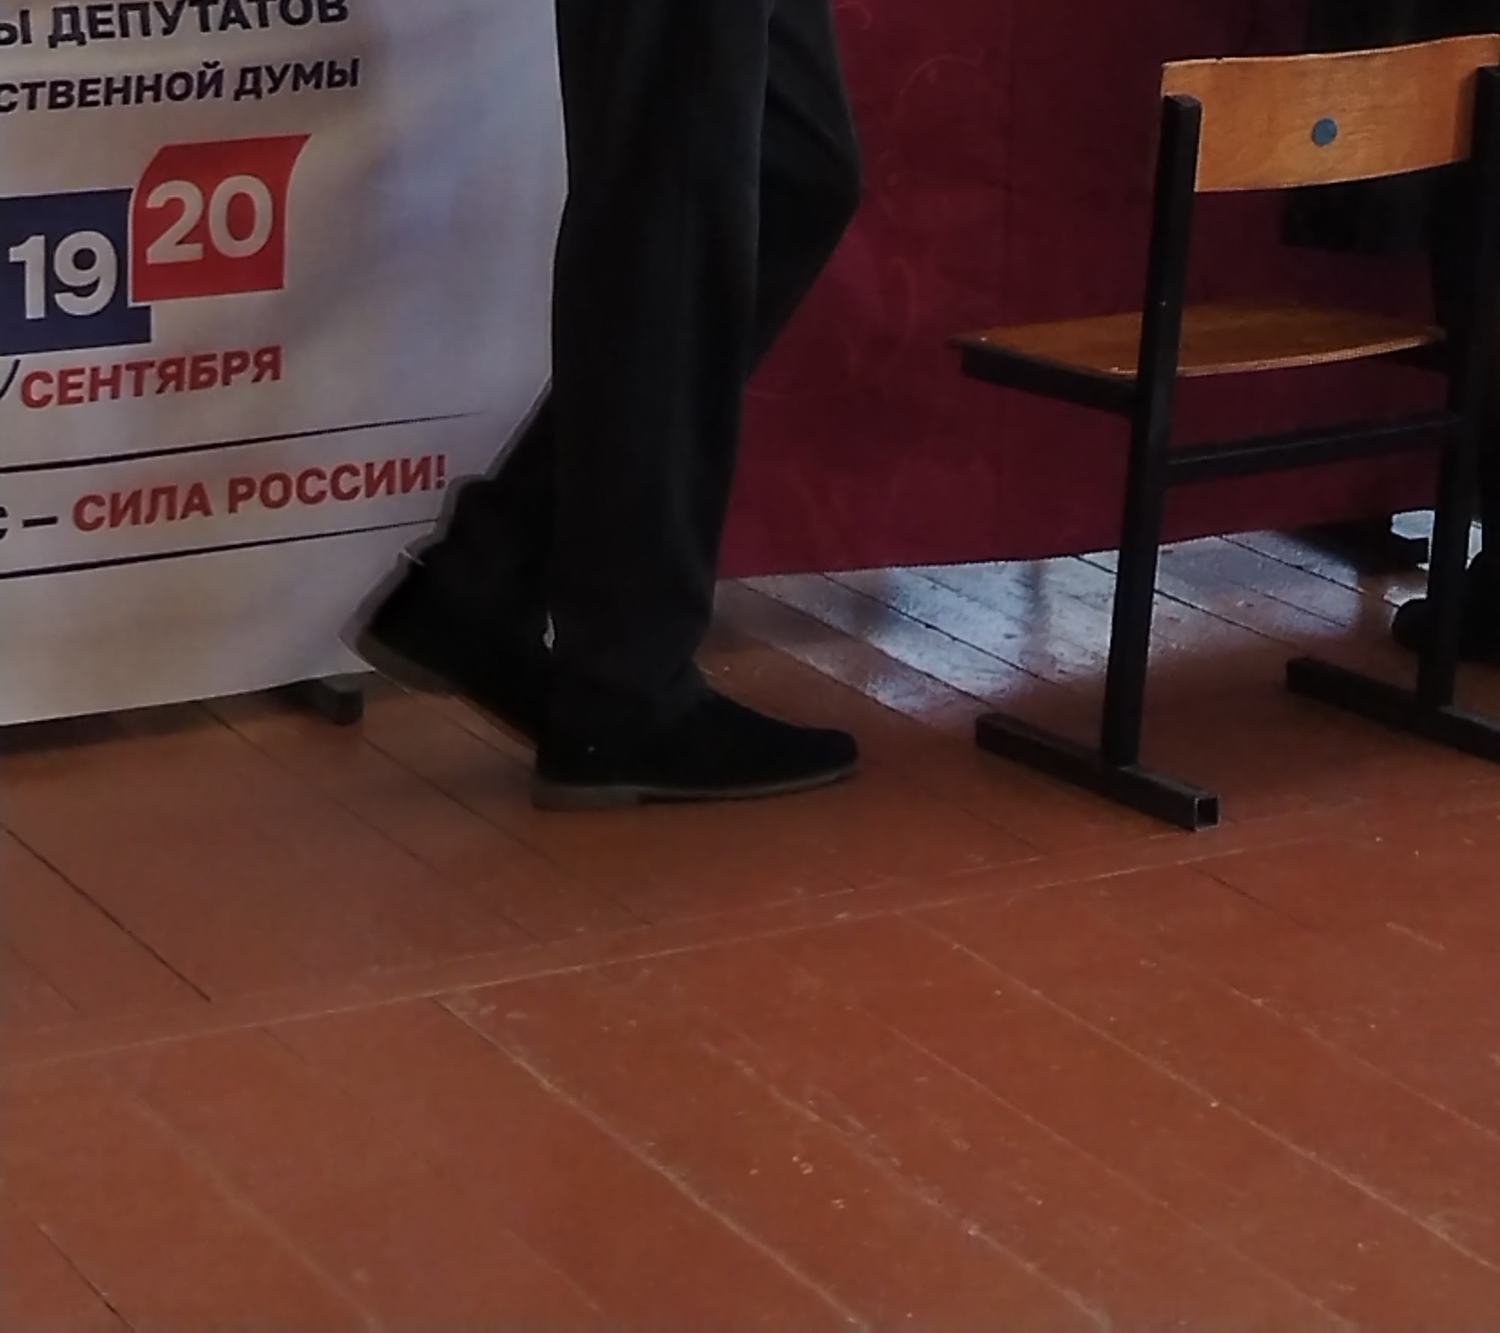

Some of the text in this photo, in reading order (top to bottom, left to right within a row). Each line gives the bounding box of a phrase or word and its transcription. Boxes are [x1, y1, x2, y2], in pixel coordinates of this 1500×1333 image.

[0, 57, 361, 114] СТВЕННОЙ ДУМЫ
[146, 174, 273, 265] 20
[8, 230, 118, 320] 19
[20, 345, 282, 410] СЕНТЯБРЯ
[72, 482, 214, 533] СИЛА
[227, 454, 447, 515] РОССИИ!
